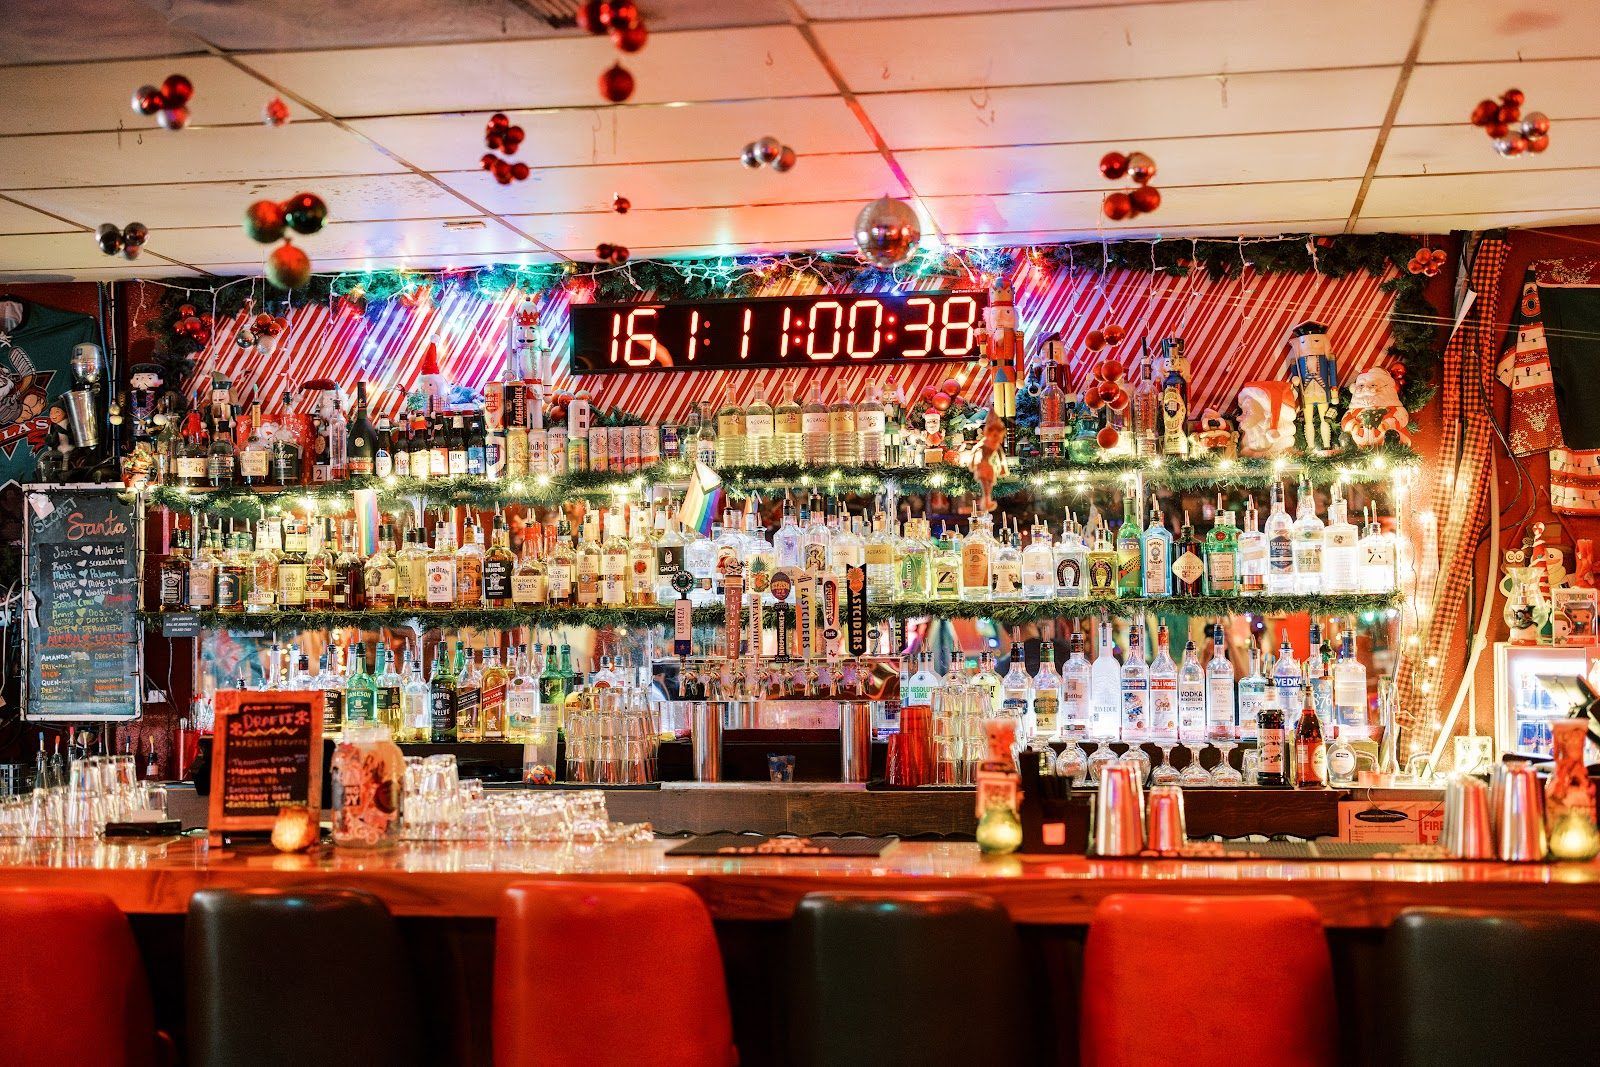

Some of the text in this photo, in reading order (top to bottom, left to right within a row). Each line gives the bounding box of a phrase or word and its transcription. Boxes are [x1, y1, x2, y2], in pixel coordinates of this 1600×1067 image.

[316, 469, 322, 480] 2
[33, 497, 77, 533] SECRET
[67, 510, 128, 540] Santa
[801, 587, 810, 649] EASTCIDERS
[852, 592, 863, 650] STCIDERS
